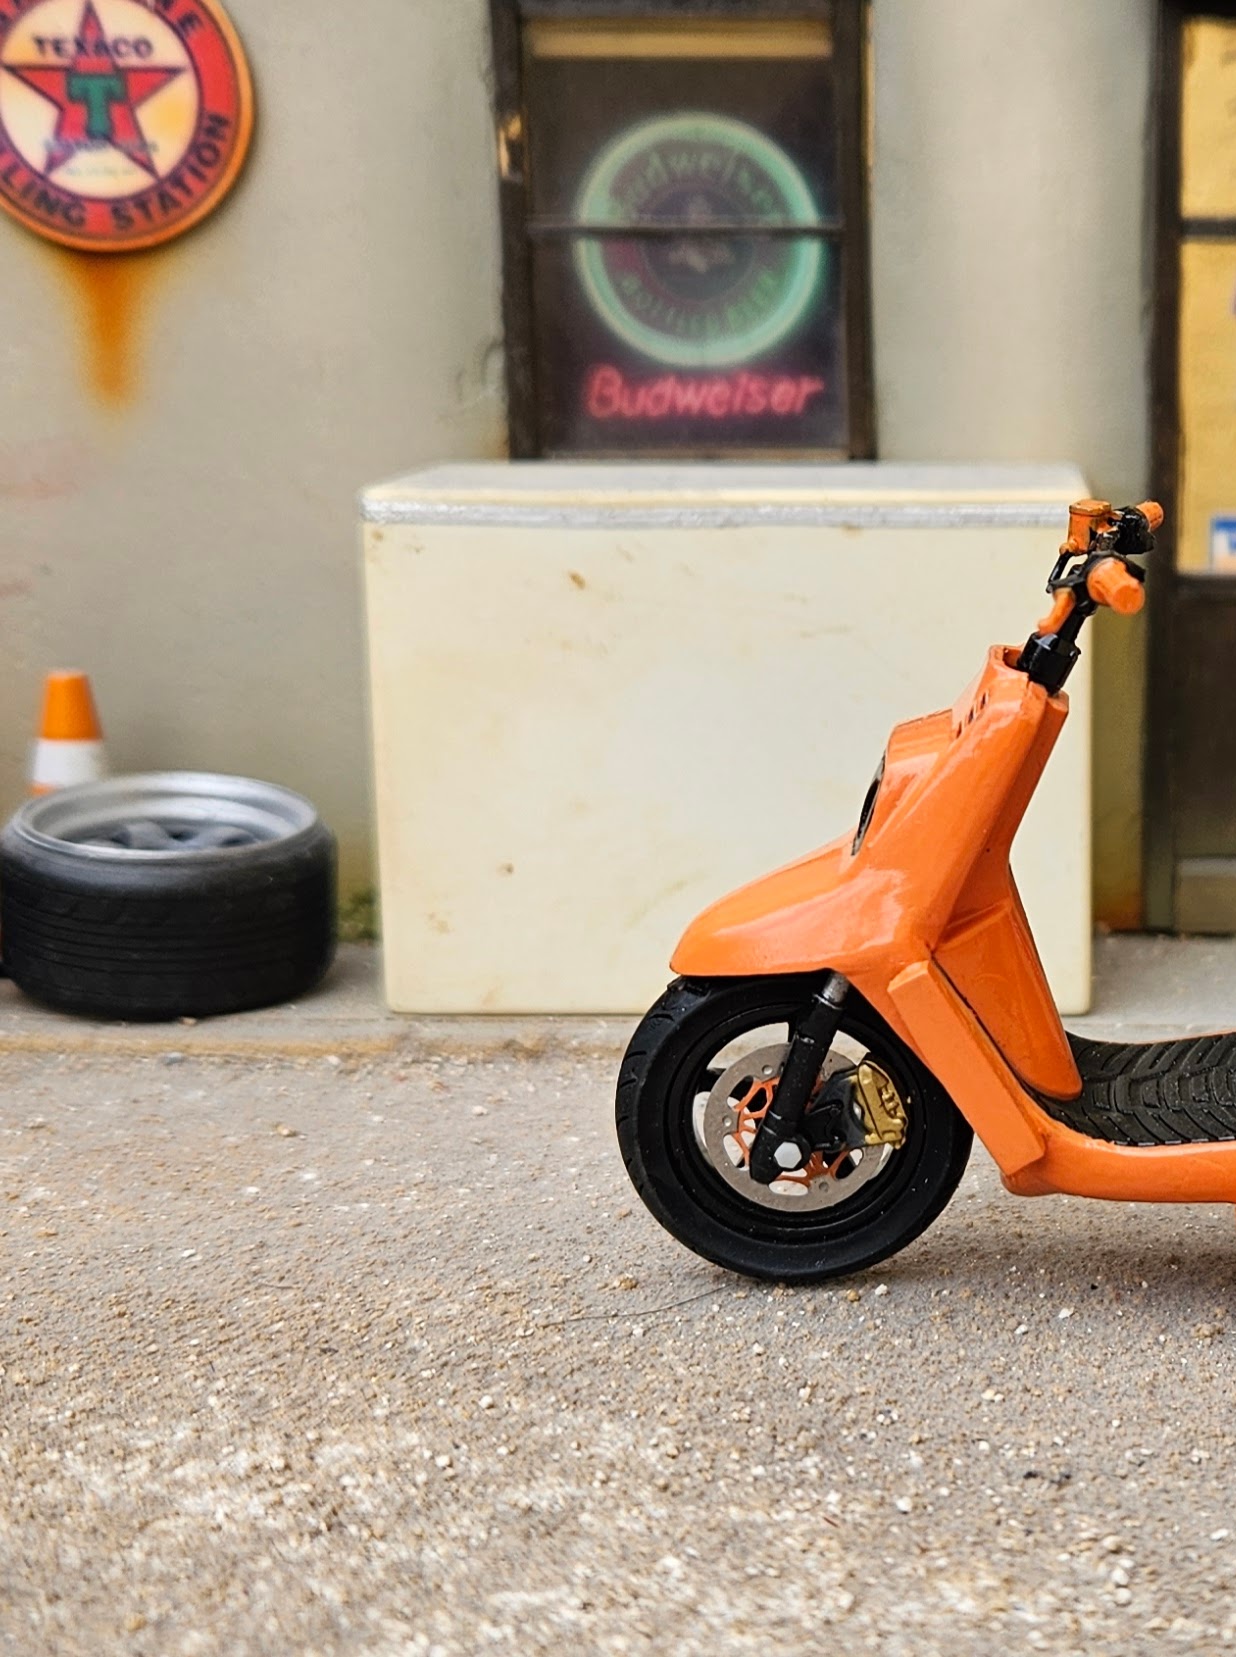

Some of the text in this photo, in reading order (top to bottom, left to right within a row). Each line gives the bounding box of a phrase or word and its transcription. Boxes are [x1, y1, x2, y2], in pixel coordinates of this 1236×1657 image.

[33, 35, 153, 59] TEXACO
[66, 73, 128, 138] T
[0, 111, 230, 233] LING STATION
[584, 363, 825, 420] Budweiser
